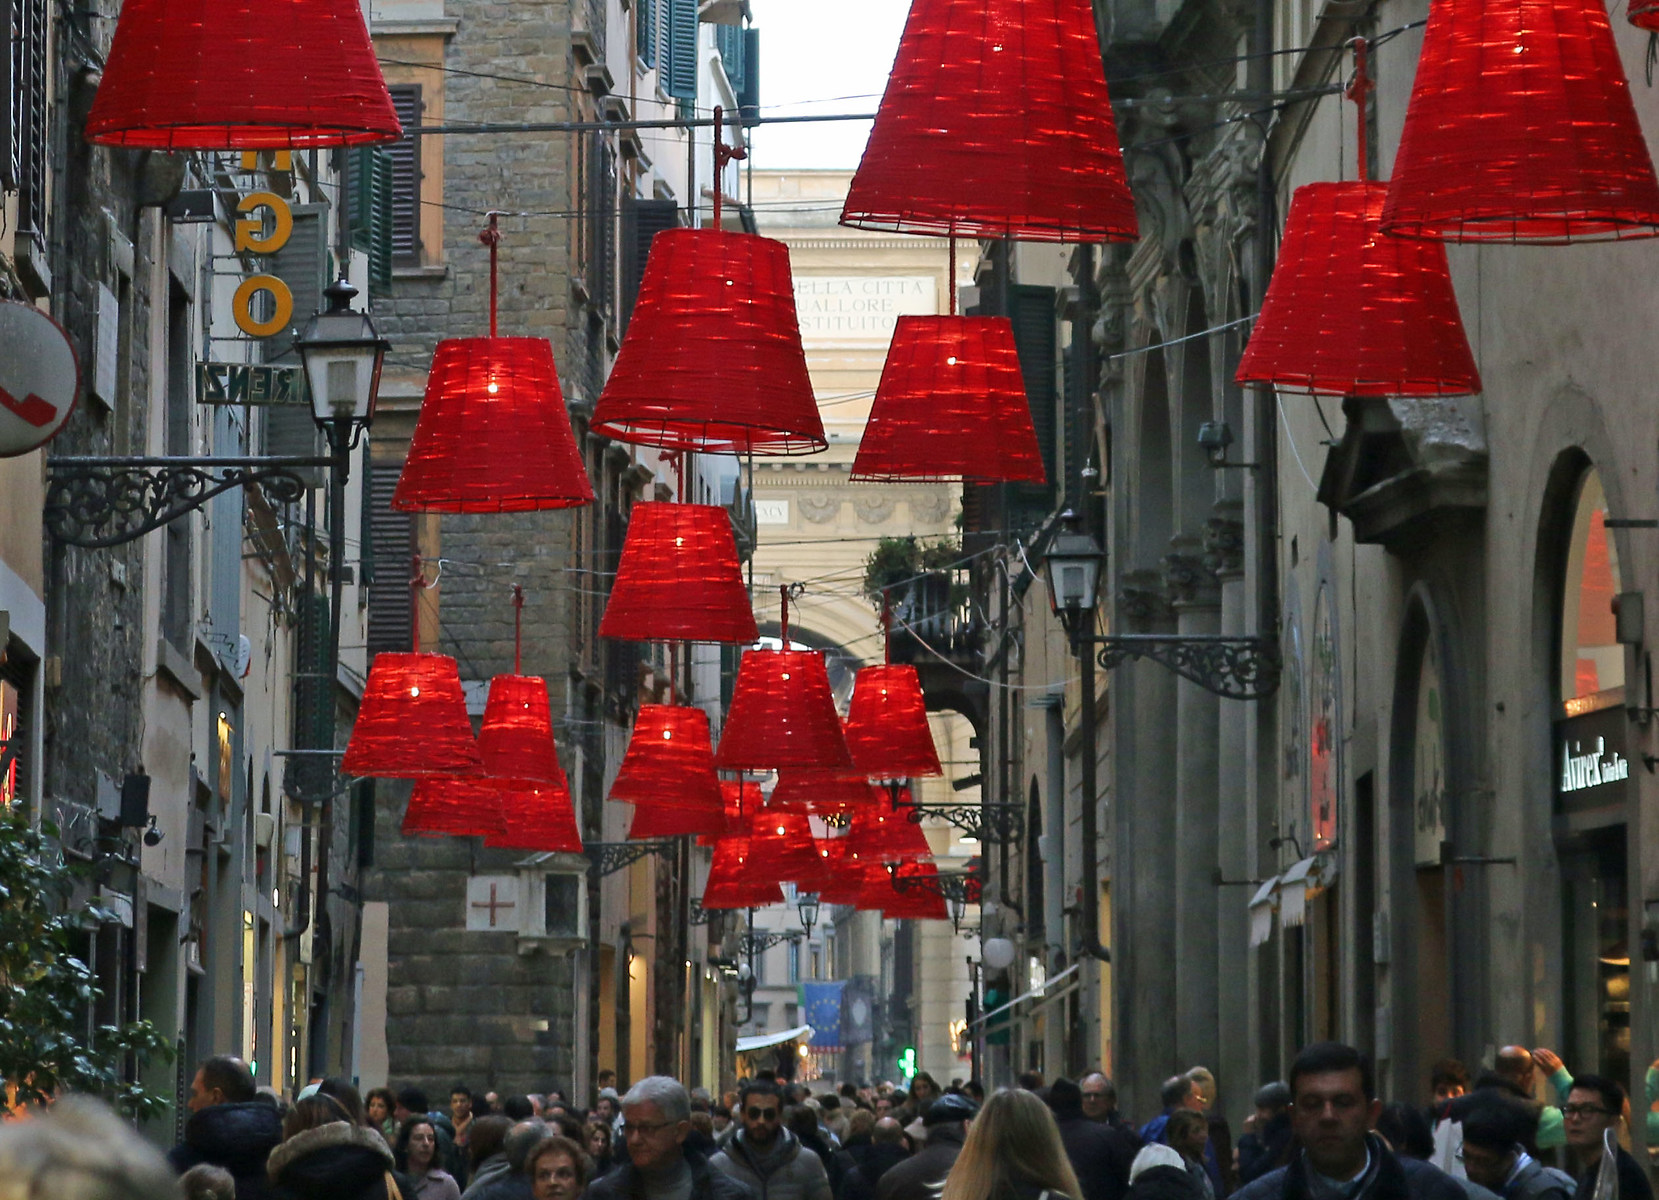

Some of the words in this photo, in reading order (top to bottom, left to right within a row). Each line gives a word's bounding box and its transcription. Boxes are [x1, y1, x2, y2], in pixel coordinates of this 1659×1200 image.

[793, 281, 853, 295] ELLA
[797, 299, 893, 312] UALLORE
[800, 316, 894, 330] STITUITO
